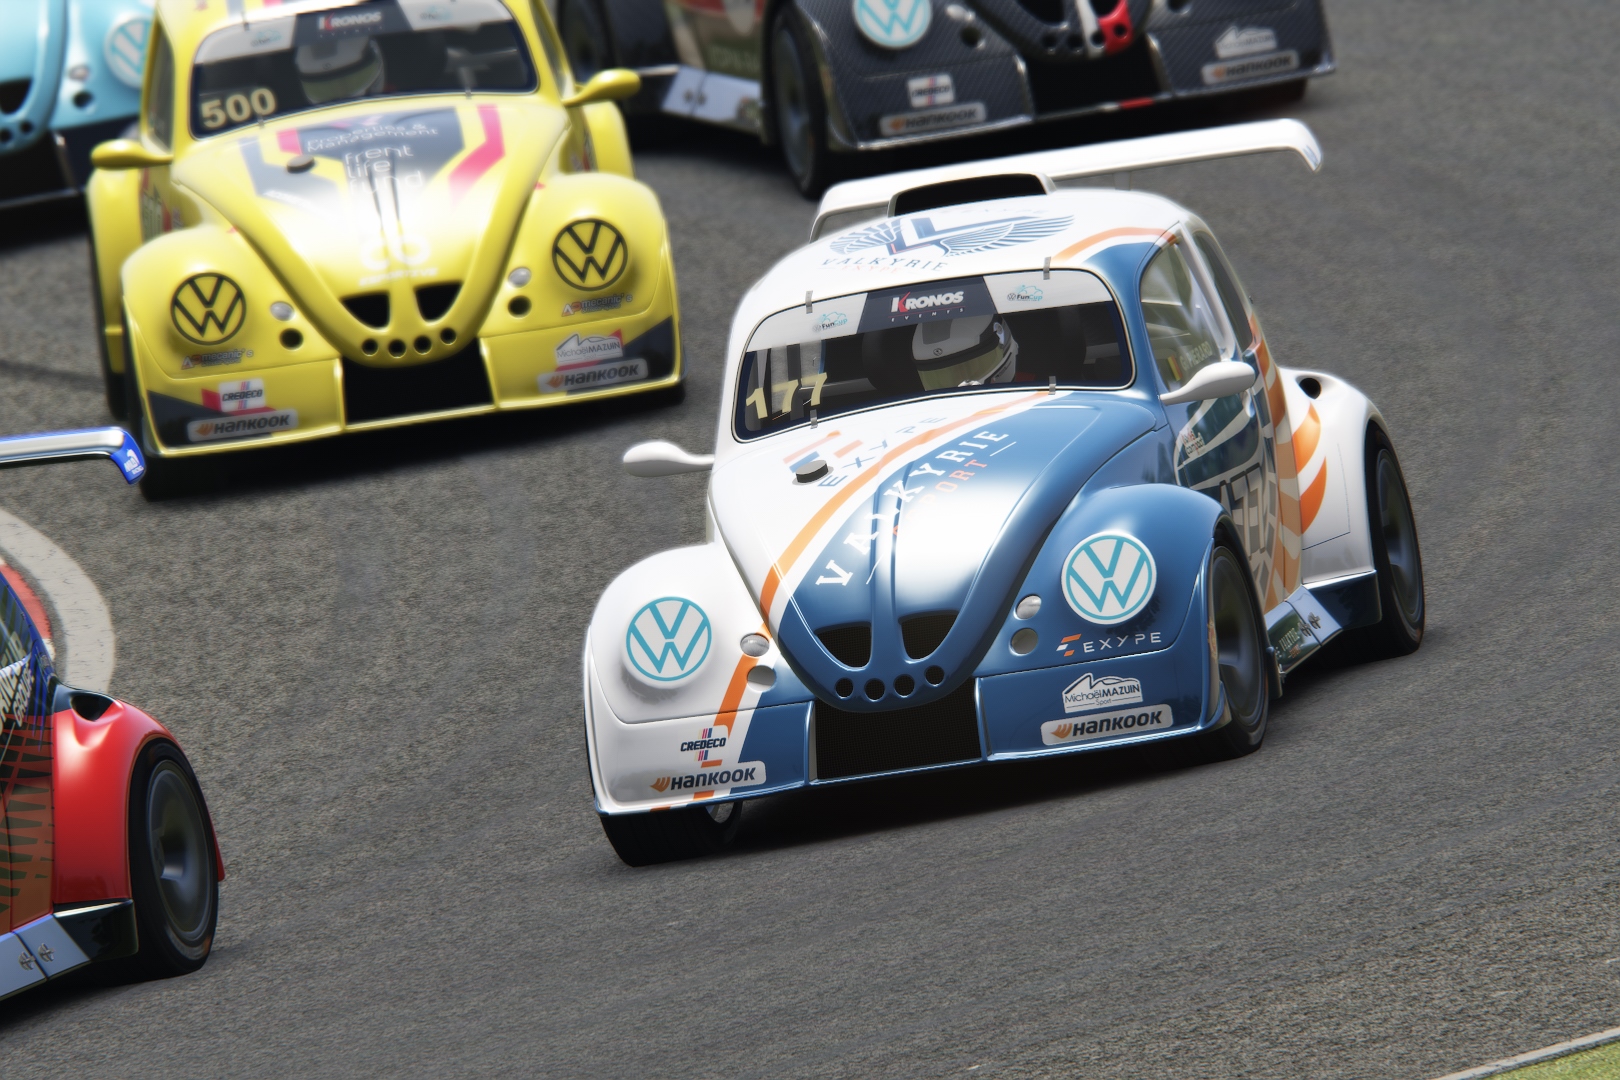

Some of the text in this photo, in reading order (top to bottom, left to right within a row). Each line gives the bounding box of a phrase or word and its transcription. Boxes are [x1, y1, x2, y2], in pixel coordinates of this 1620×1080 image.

[318, 11, 382, 31] KRONOS
[201, 88, 276, 129] 500
[821, 257, 949, 273] VALKYRIE
[891, 291, 964, 312] KRONOS
[222, 389, 263, 401] CREDECO
[745, 372, 827, 420] 177
[817, 417, 948, 487] EXYPE
[815, 430, 1009, 586] VALKYRIE
[1083, 632, 1162, 653] EXYPE
[1095, 698, 1112, 706] Sport
[680, 737, 726, 752] CREDECO
